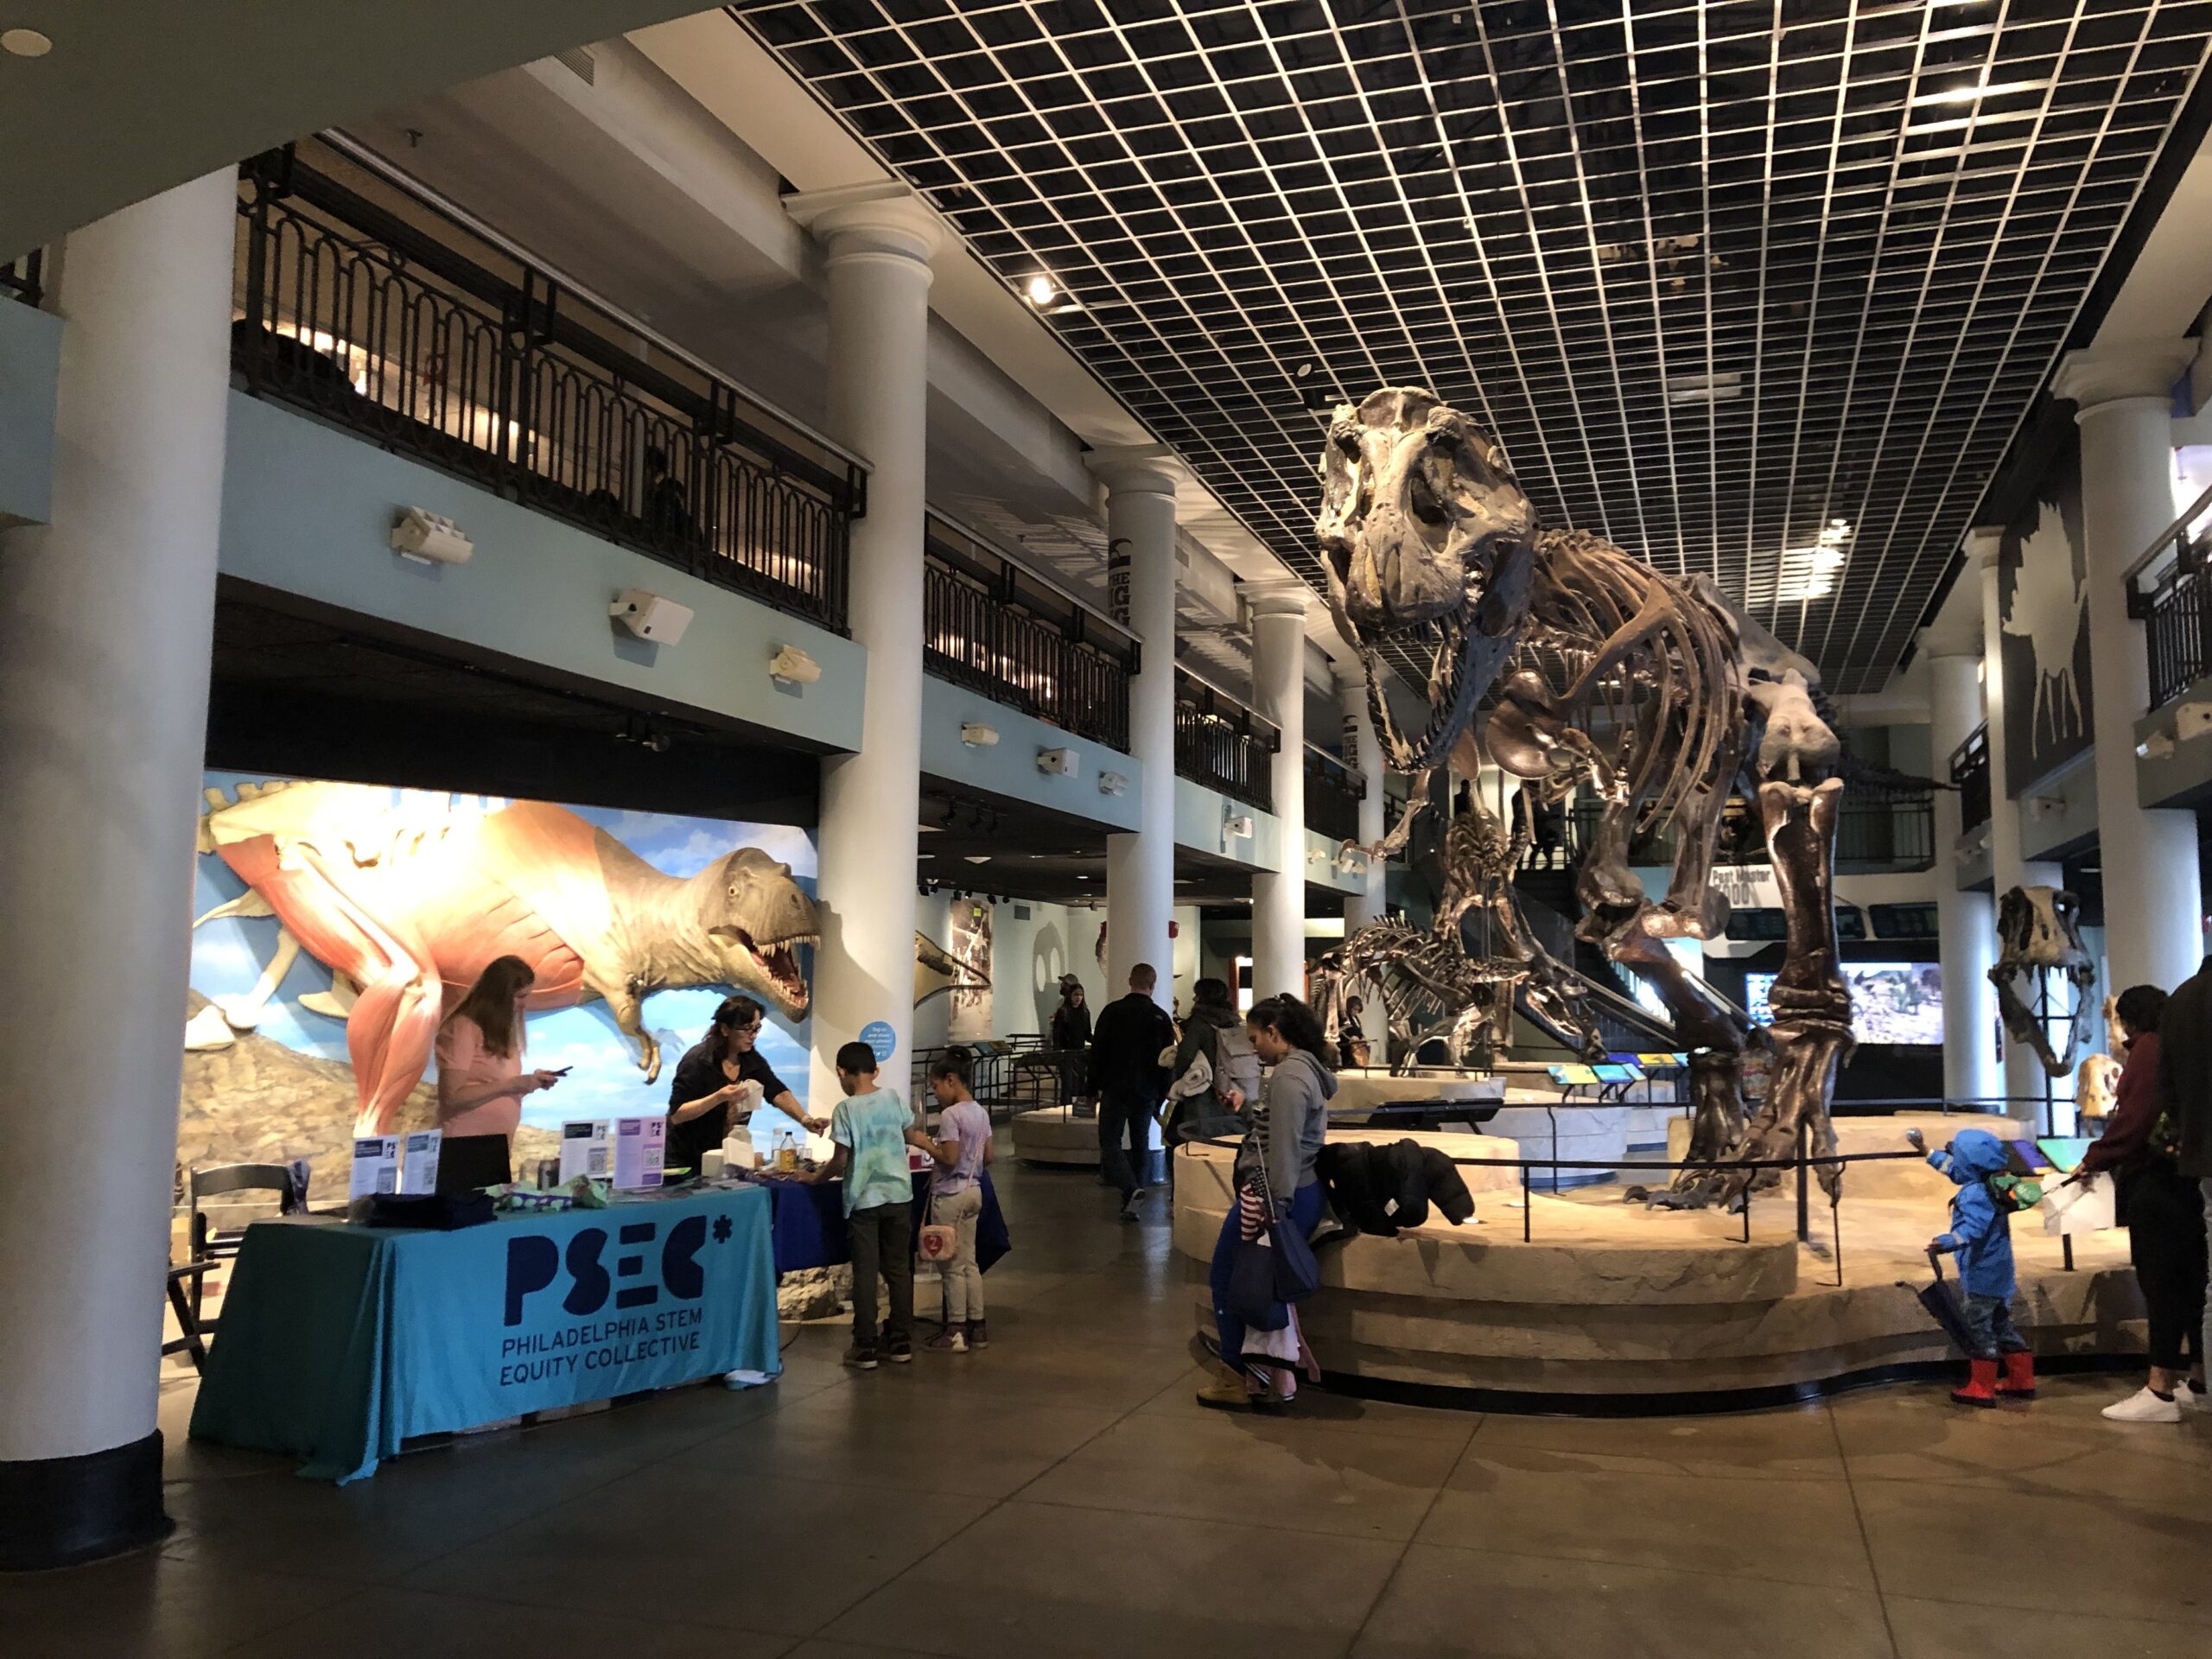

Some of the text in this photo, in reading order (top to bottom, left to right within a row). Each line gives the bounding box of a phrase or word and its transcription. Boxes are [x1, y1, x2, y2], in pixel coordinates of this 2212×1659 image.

[1109, 585, 1130, 608] IG
[1714, 883, 1750, 905] 000
[502, 1307, 702, 1358] PHILADELPHIA STEM
[499, 1332, 701, 1386] EQUITY COLLECTIVE
